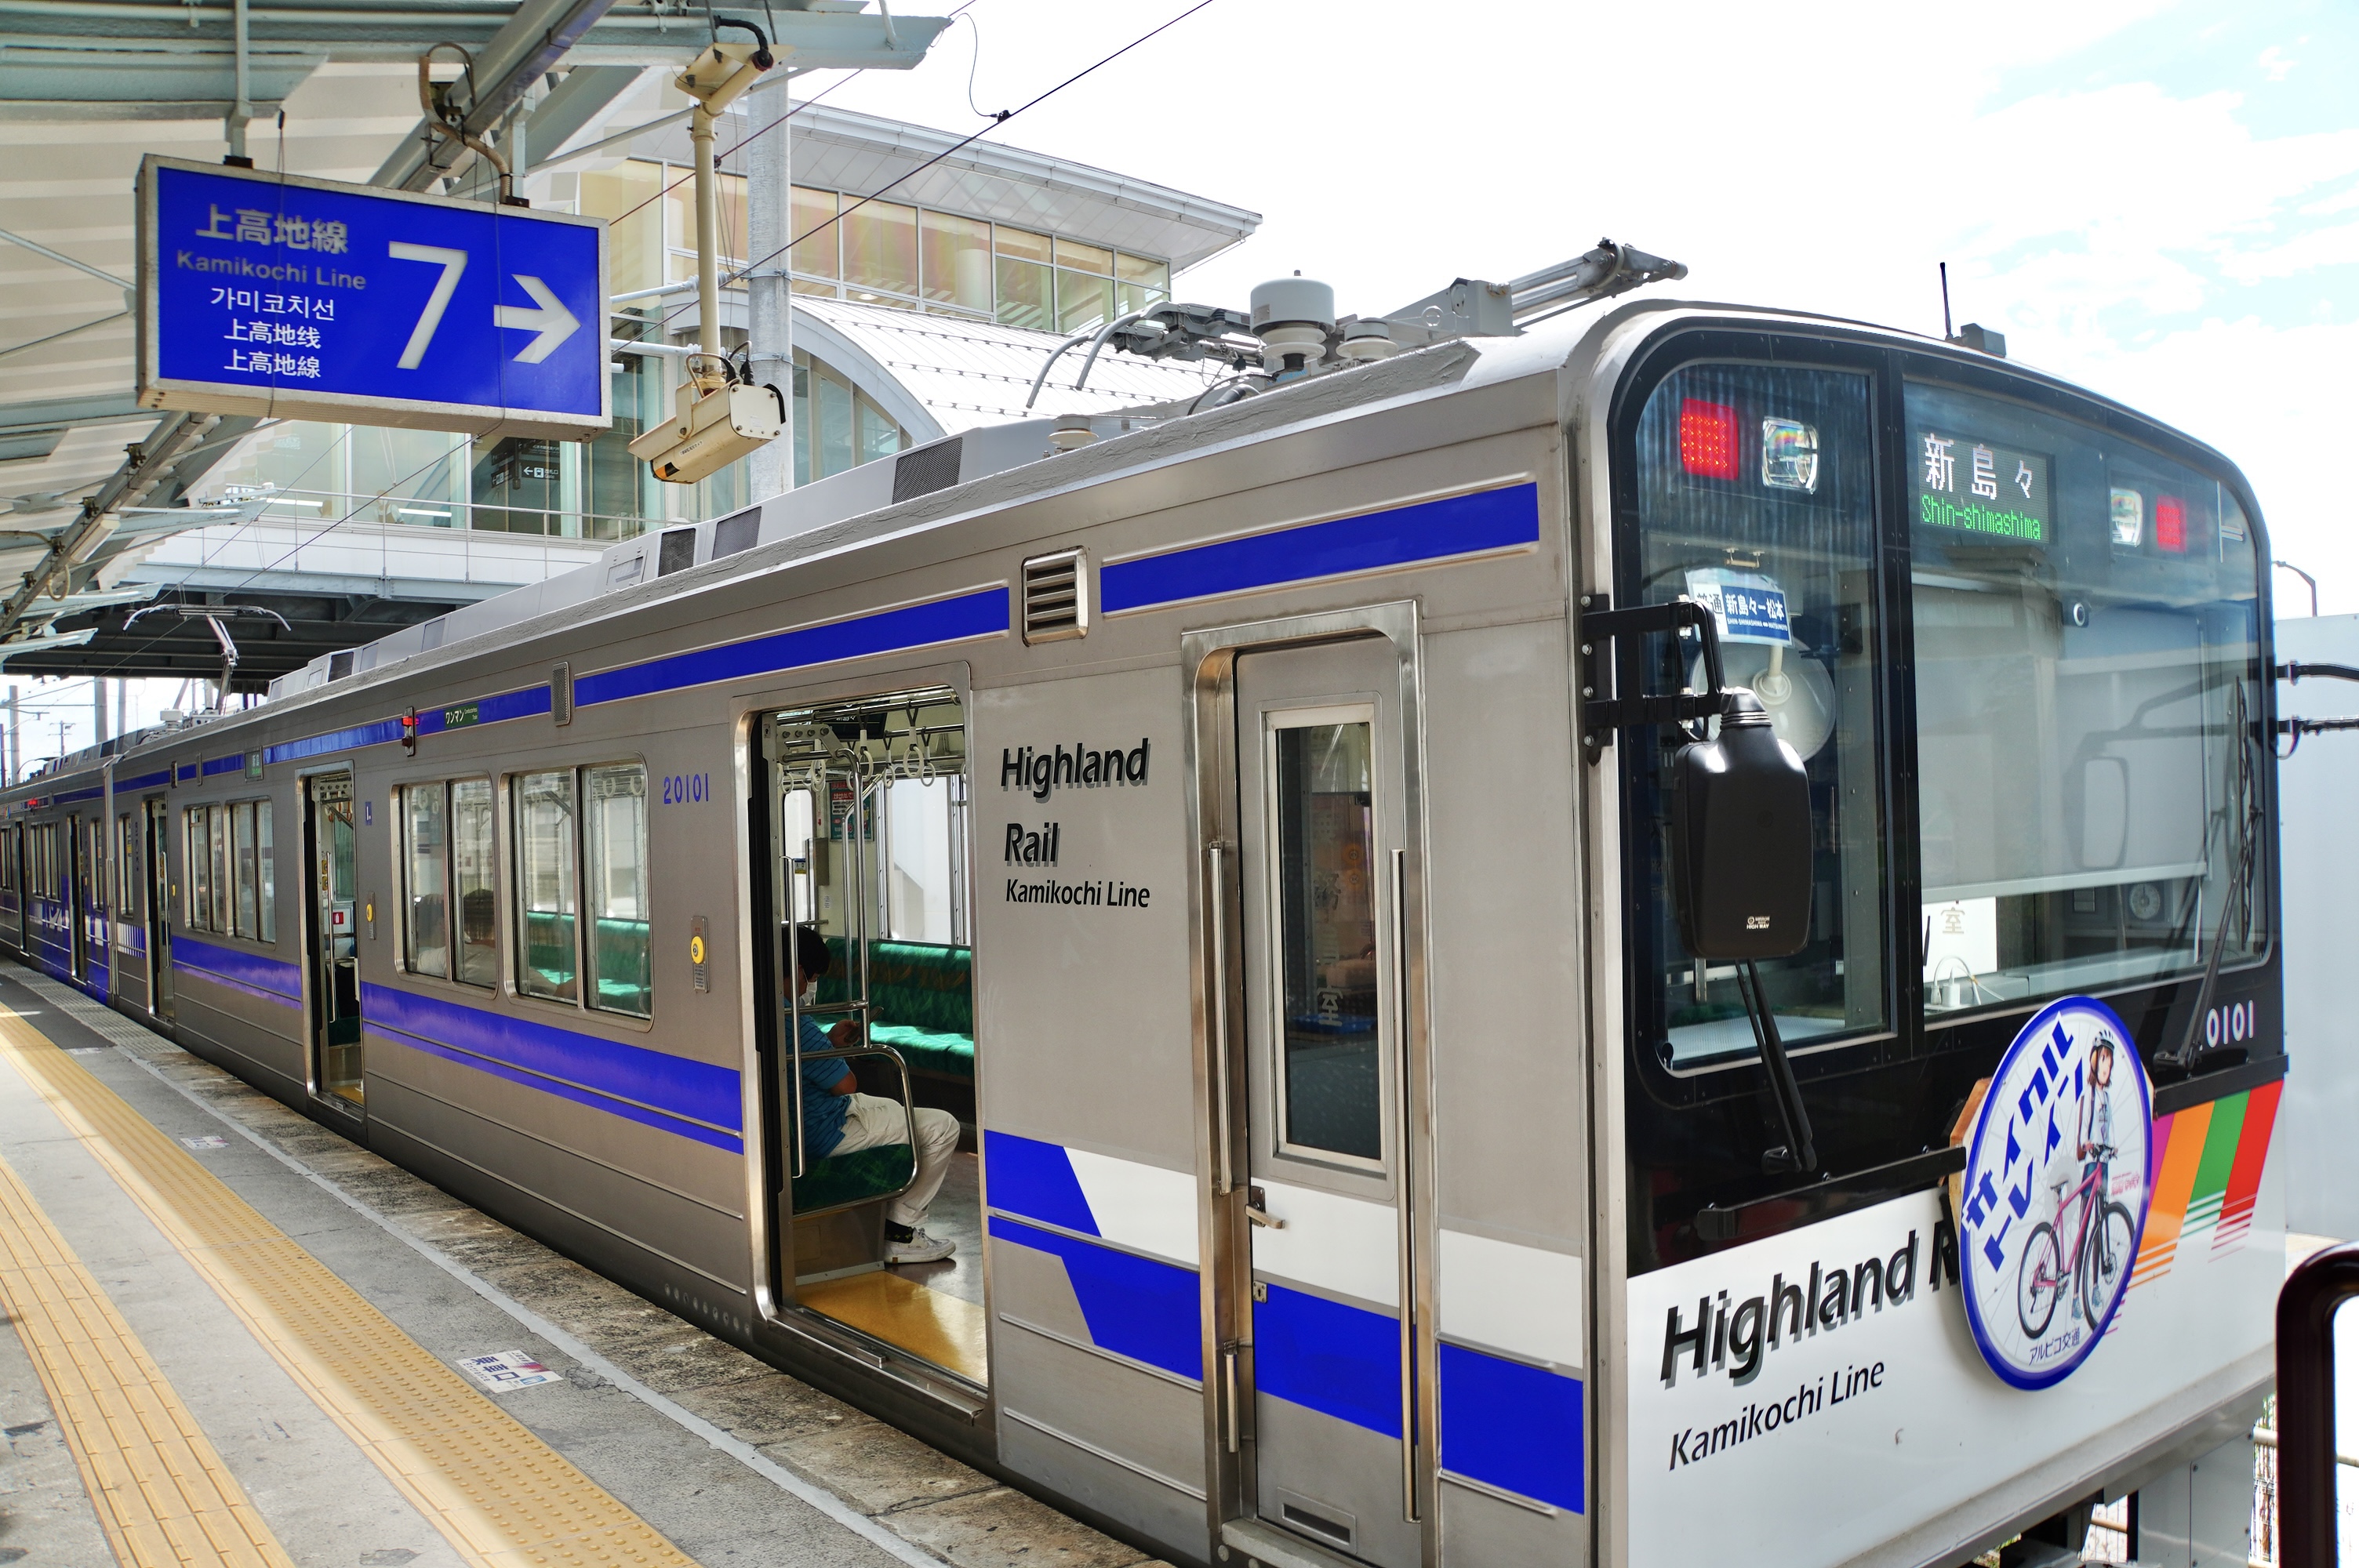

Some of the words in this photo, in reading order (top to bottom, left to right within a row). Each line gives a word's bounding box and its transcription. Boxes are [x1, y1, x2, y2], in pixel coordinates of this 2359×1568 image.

[195, 203, 349, 254] 上高地線
[176, 249, 308, 284] Kamikochi
[315, 266, 367, 290] Line
[209, 287, 335, 321] 가미코치선
[388, 241, 468, 370] 7
[224, 318, 322, 350] 上高地线
[224, 348, 322, 379] 上高地線
[1924, 433, 2034, 500] 新島々
[1921, 494, 2041, 540] Shin-shimashima
[445, 710, 464, 724] ワンマン
[663, 772, 710, 804] 20101
[1001, 737, 1151, 804] Highland
[1005, 822, 1060, 868] Rail
[1005, 878, 1102, 906] Kamikochi
[1107, 881, 1150, 908] Line
[2199, 1000, 2254, 1048] 0101
[1967, 1021, 2074, 1231] サイクル
[1983, 1055, 2083, 1273] トレイン
[1659, 1229, 1920, 1390] Highland
[470, 1356, 521, 1381] 乗車口
[2029, 1326, 2081, 1367] アルピコ交通
[1669, 1376, 1824, 1472] Kamikochi
[1830, 1361, 1885, 1406] Line
